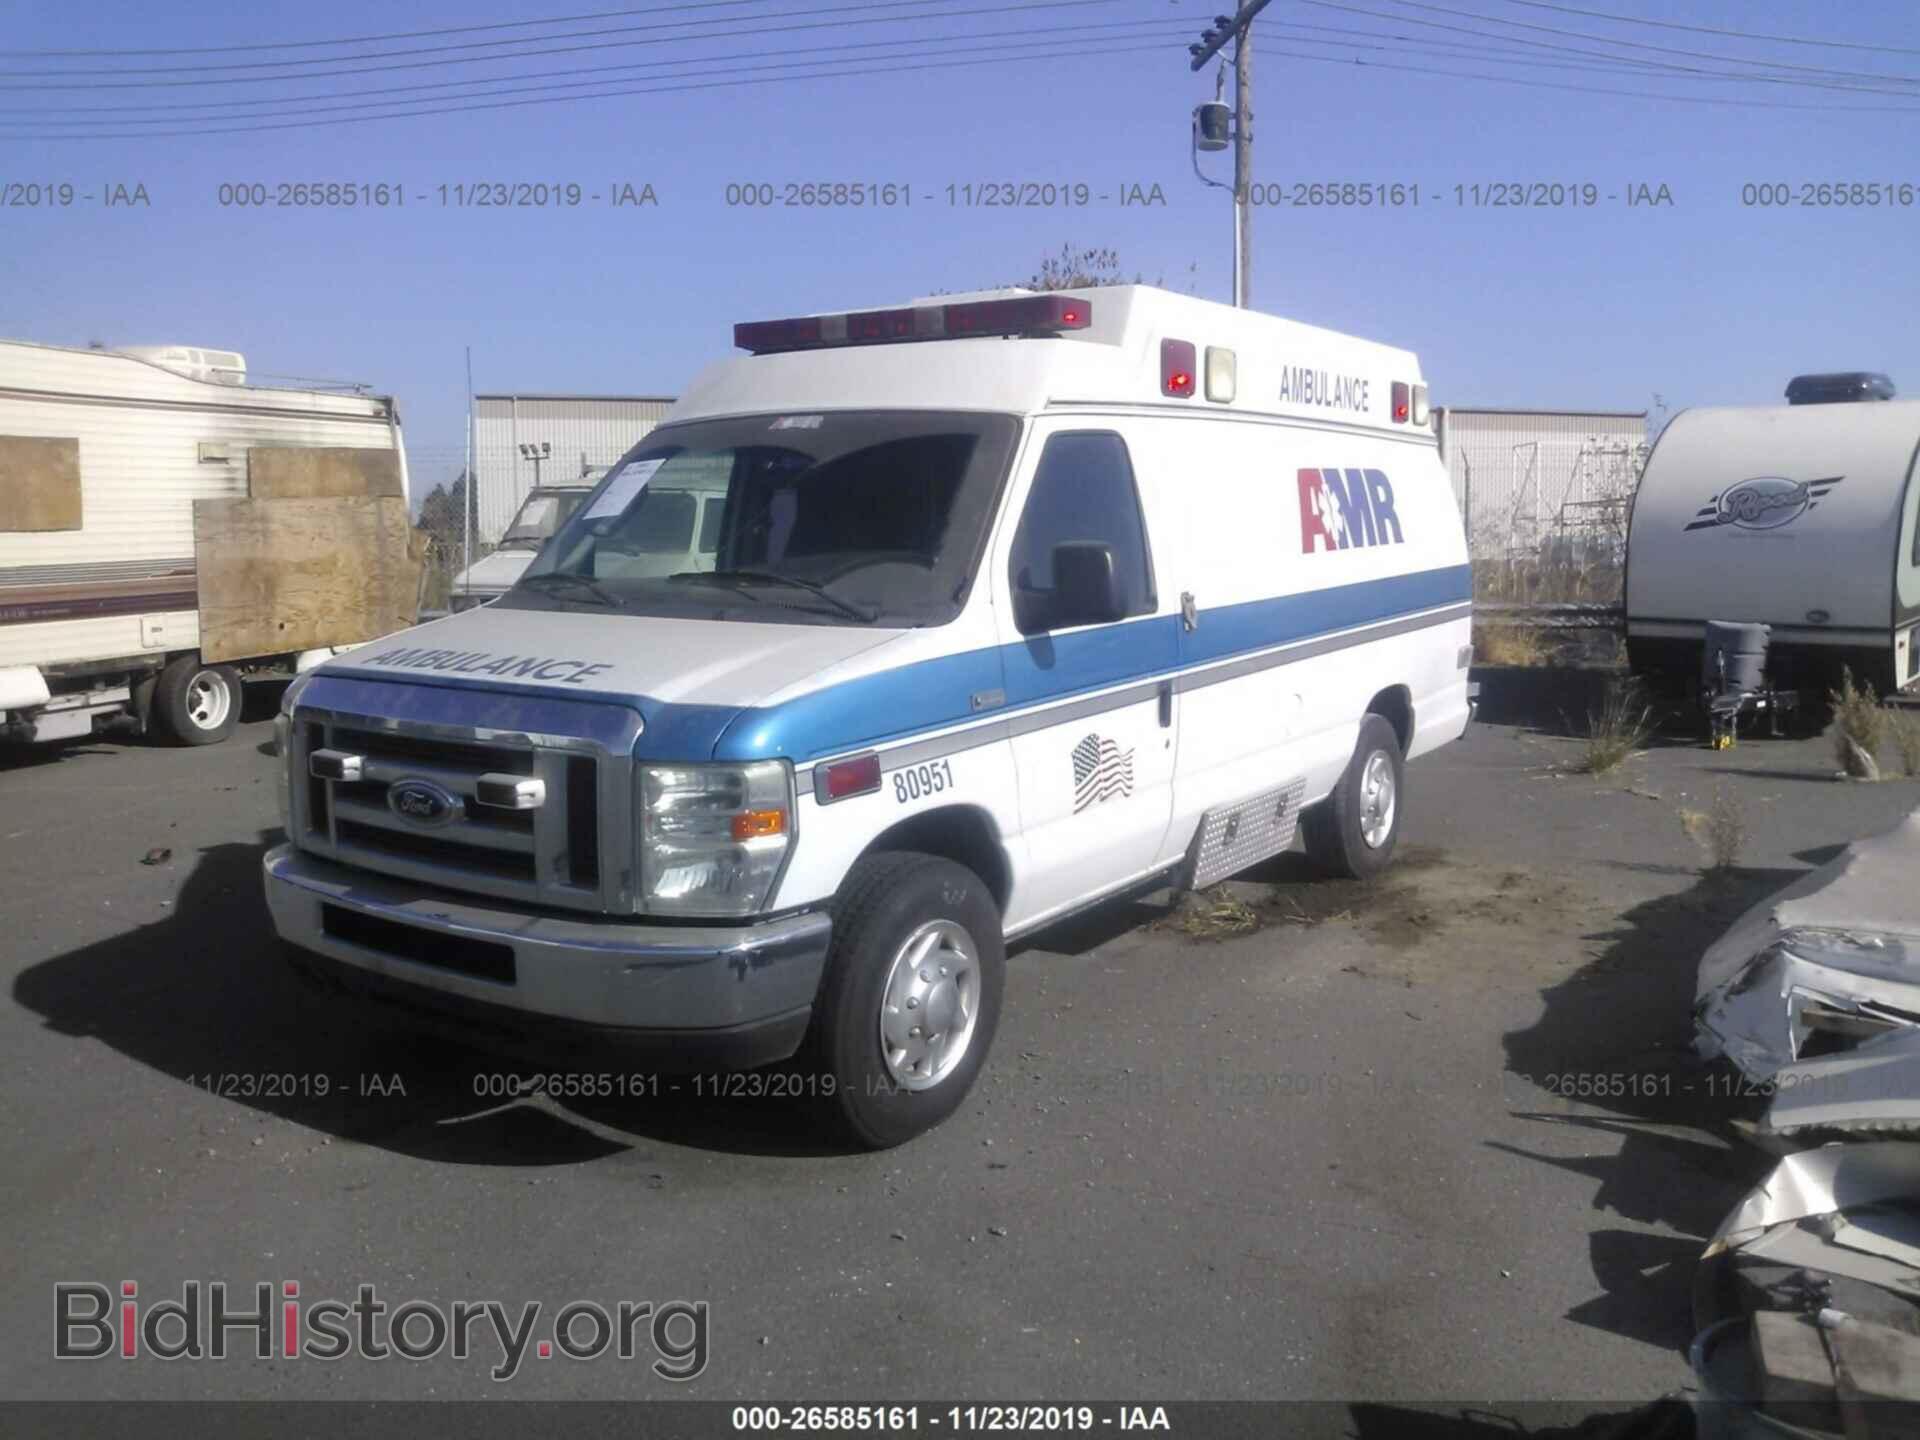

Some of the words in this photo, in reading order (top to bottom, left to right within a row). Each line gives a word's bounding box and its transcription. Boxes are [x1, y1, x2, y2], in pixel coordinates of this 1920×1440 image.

[1280, 365, 1369, 412] AMBULANCE
[1297, 468, 1404, 554] AMR
[361, 647, 615, 683] AMBULANCE
[401, 790, 434, 815] Ford
[893, 759, 953, 804] 80951
